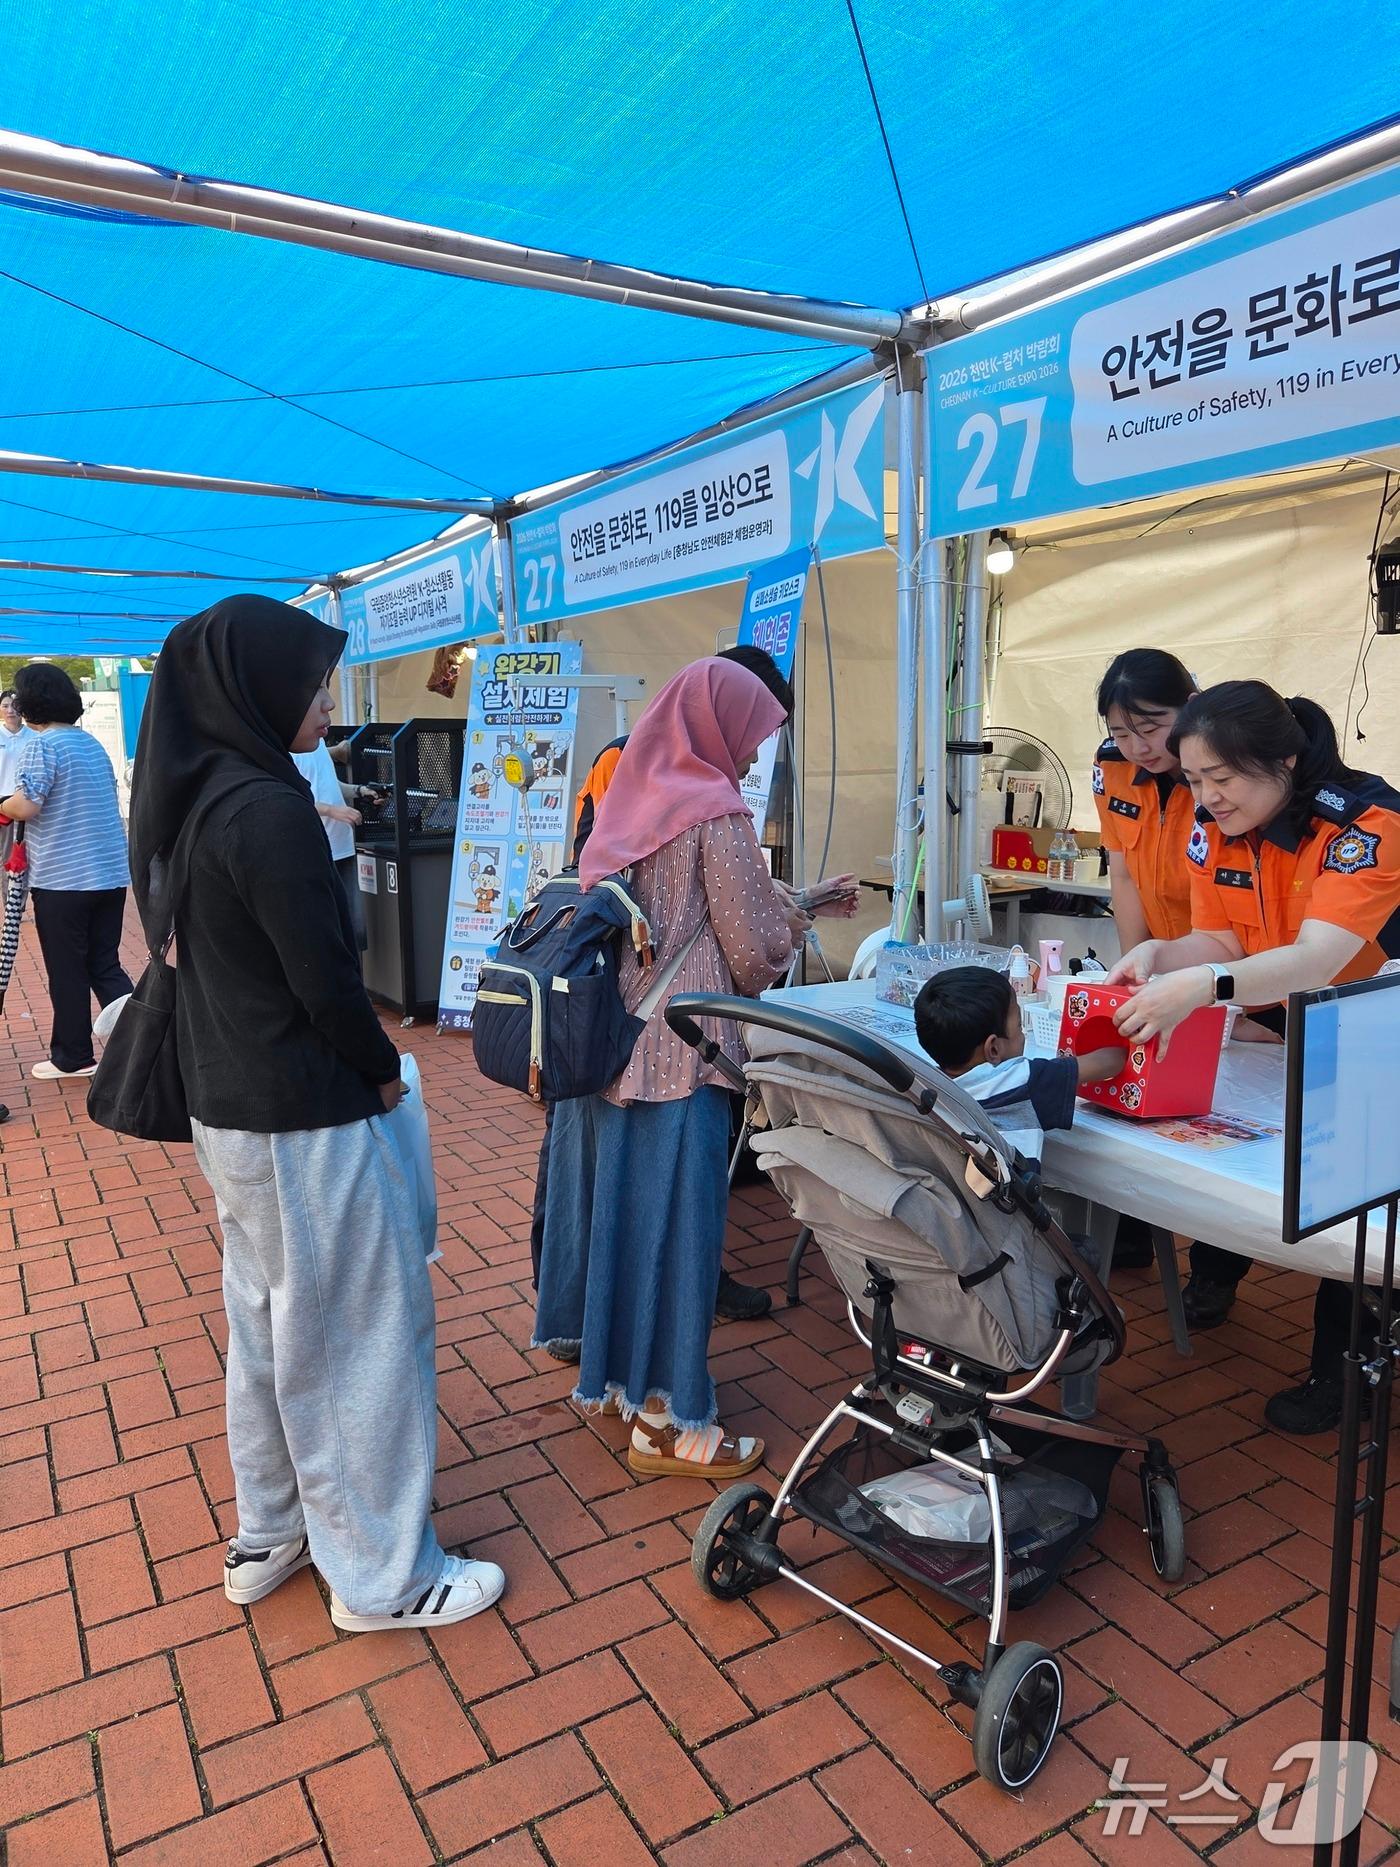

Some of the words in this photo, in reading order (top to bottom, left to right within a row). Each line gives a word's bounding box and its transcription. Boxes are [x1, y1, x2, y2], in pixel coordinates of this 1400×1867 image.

[1101, 307, 1233, 402] 안전을
[1245, 249, 1400, 360] 문화로
[939, 367, 968, 391] 2026
[1026, 333, 1061, 362] 박람회
[940, 388, 972, 409] CHEONAN
[1018, 369, 1038, 386] EXPO
[1039, 362, 1059, 379] 2026
[1106, 424, 1118, 443] A
[1121, 410, 1183, 436] Culture
[1187, 401, 1206, 422] of
[1209, 387, 1273, 418] Safety,
[1276, 372, 1310, 398] 119
[1316, 367, 1334, 388] in
[957, 395, 1048, 512] 27
[570, 521, 607, 562] 안전을
[608, 506, 652, 551] 문화로,
[654, 488, 699, 533] 119를
[701, 463, 774, 523] 일상으로
[573, 575, 579, 585] A
[579, 571, 597, 584] Culture
[597, 568, 603, 580] of
[602, 565, 619, 579] Safety,
[619, 560, 629, 572] 119
[629, 559, 635, 569] in
[634, 552, 660, 569] Everyday
[660, 549, 673, 561] Life
[700, 533, 734, 553] 안전체험관
[734, 524, 773, 544] 체험운영과]
[523, 555, 557, 613] 27
[755, 586, 779, 608] 심폐소생술
[779, 577, 800, 599] 키오스크
[398, 606, 409, 626] 능력
[408, 605, 418, 622] UP
[417, 597, 435, 620] 디지털
[347, 617, 365, 656] 28
[752, 611, 792, 657] 체험존
[494, 653, 560, 681] 완강기
[527, 732, 533, 740] 2
[464, 843, 470, 852] 3
[517, 844, 523, 853] 4
[389, 867, 396, 888] 8
[453, 1014, 473, 1028] 충청
